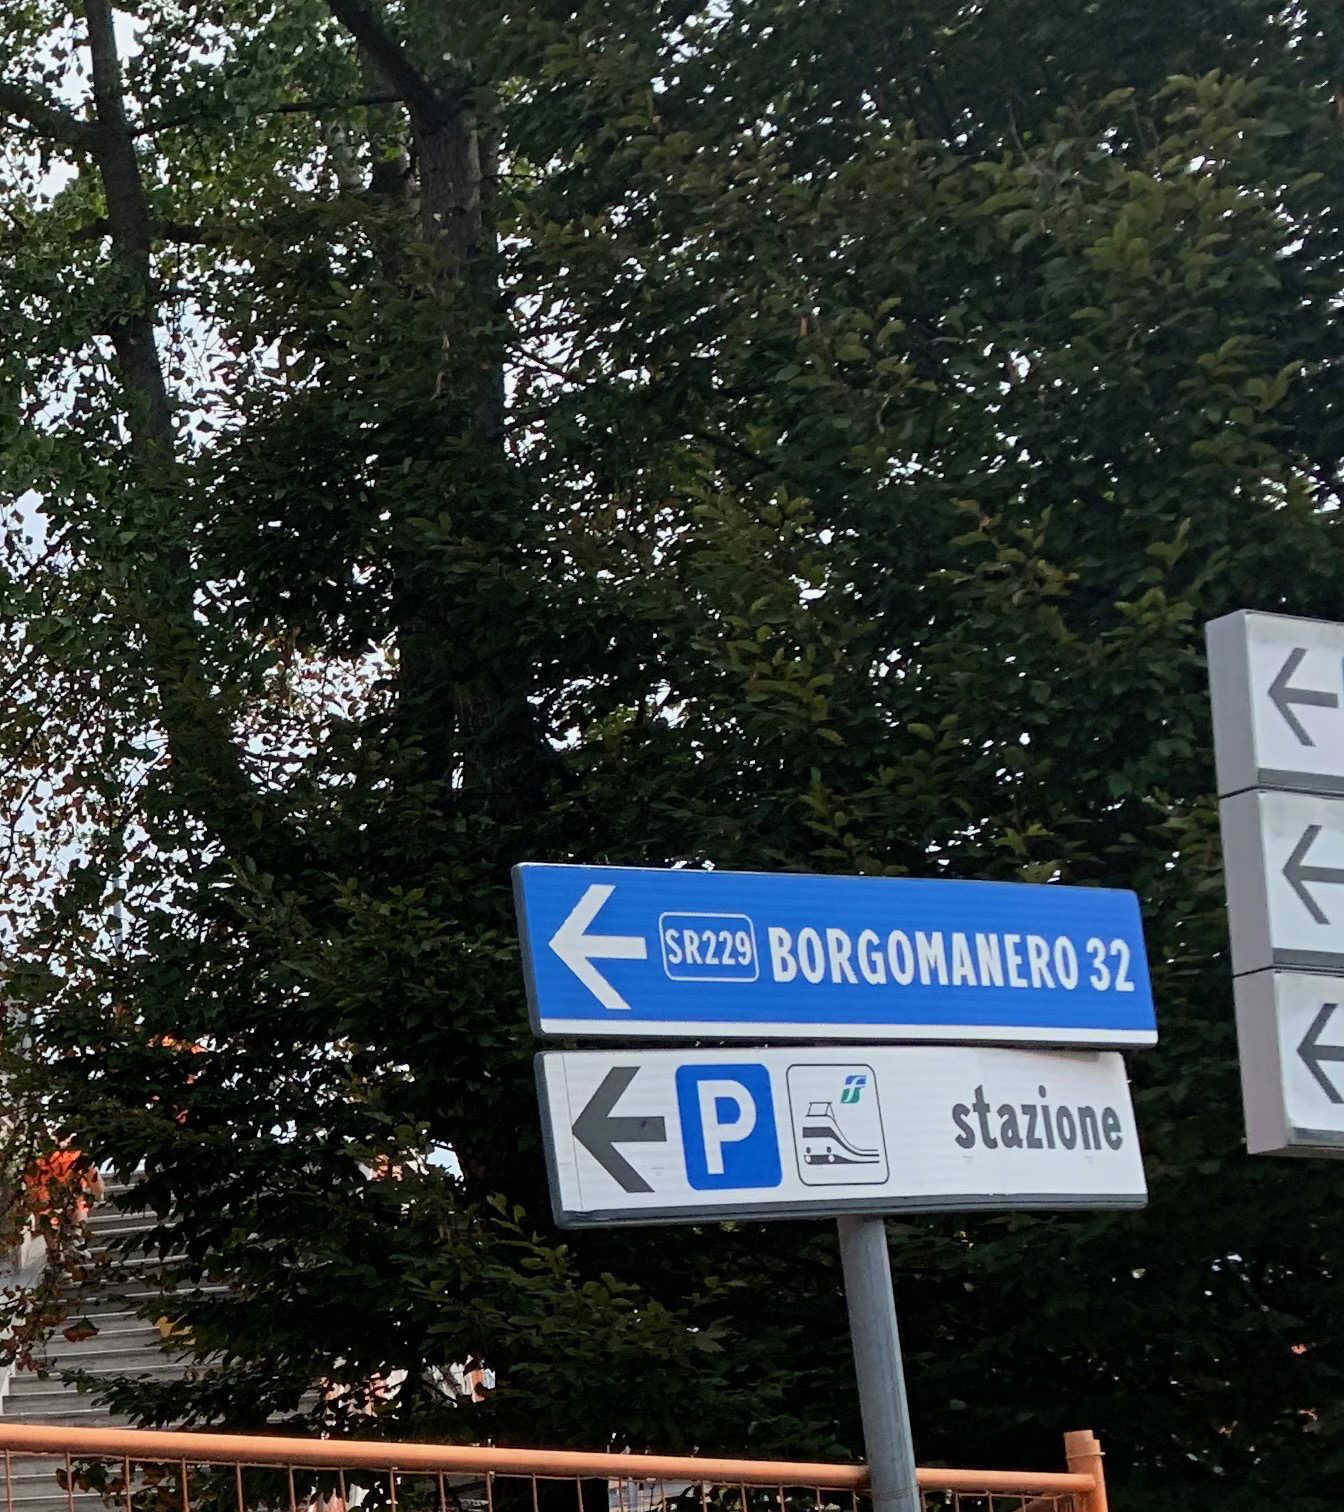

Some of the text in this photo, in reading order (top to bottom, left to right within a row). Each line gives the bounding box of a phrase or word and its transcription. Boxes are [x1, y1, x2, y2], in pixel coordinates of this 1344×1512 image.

[665, 927, 1135, 993] SR229 BORGOMANERO 32
[697, 1079, 1123, 1175] P stazione
